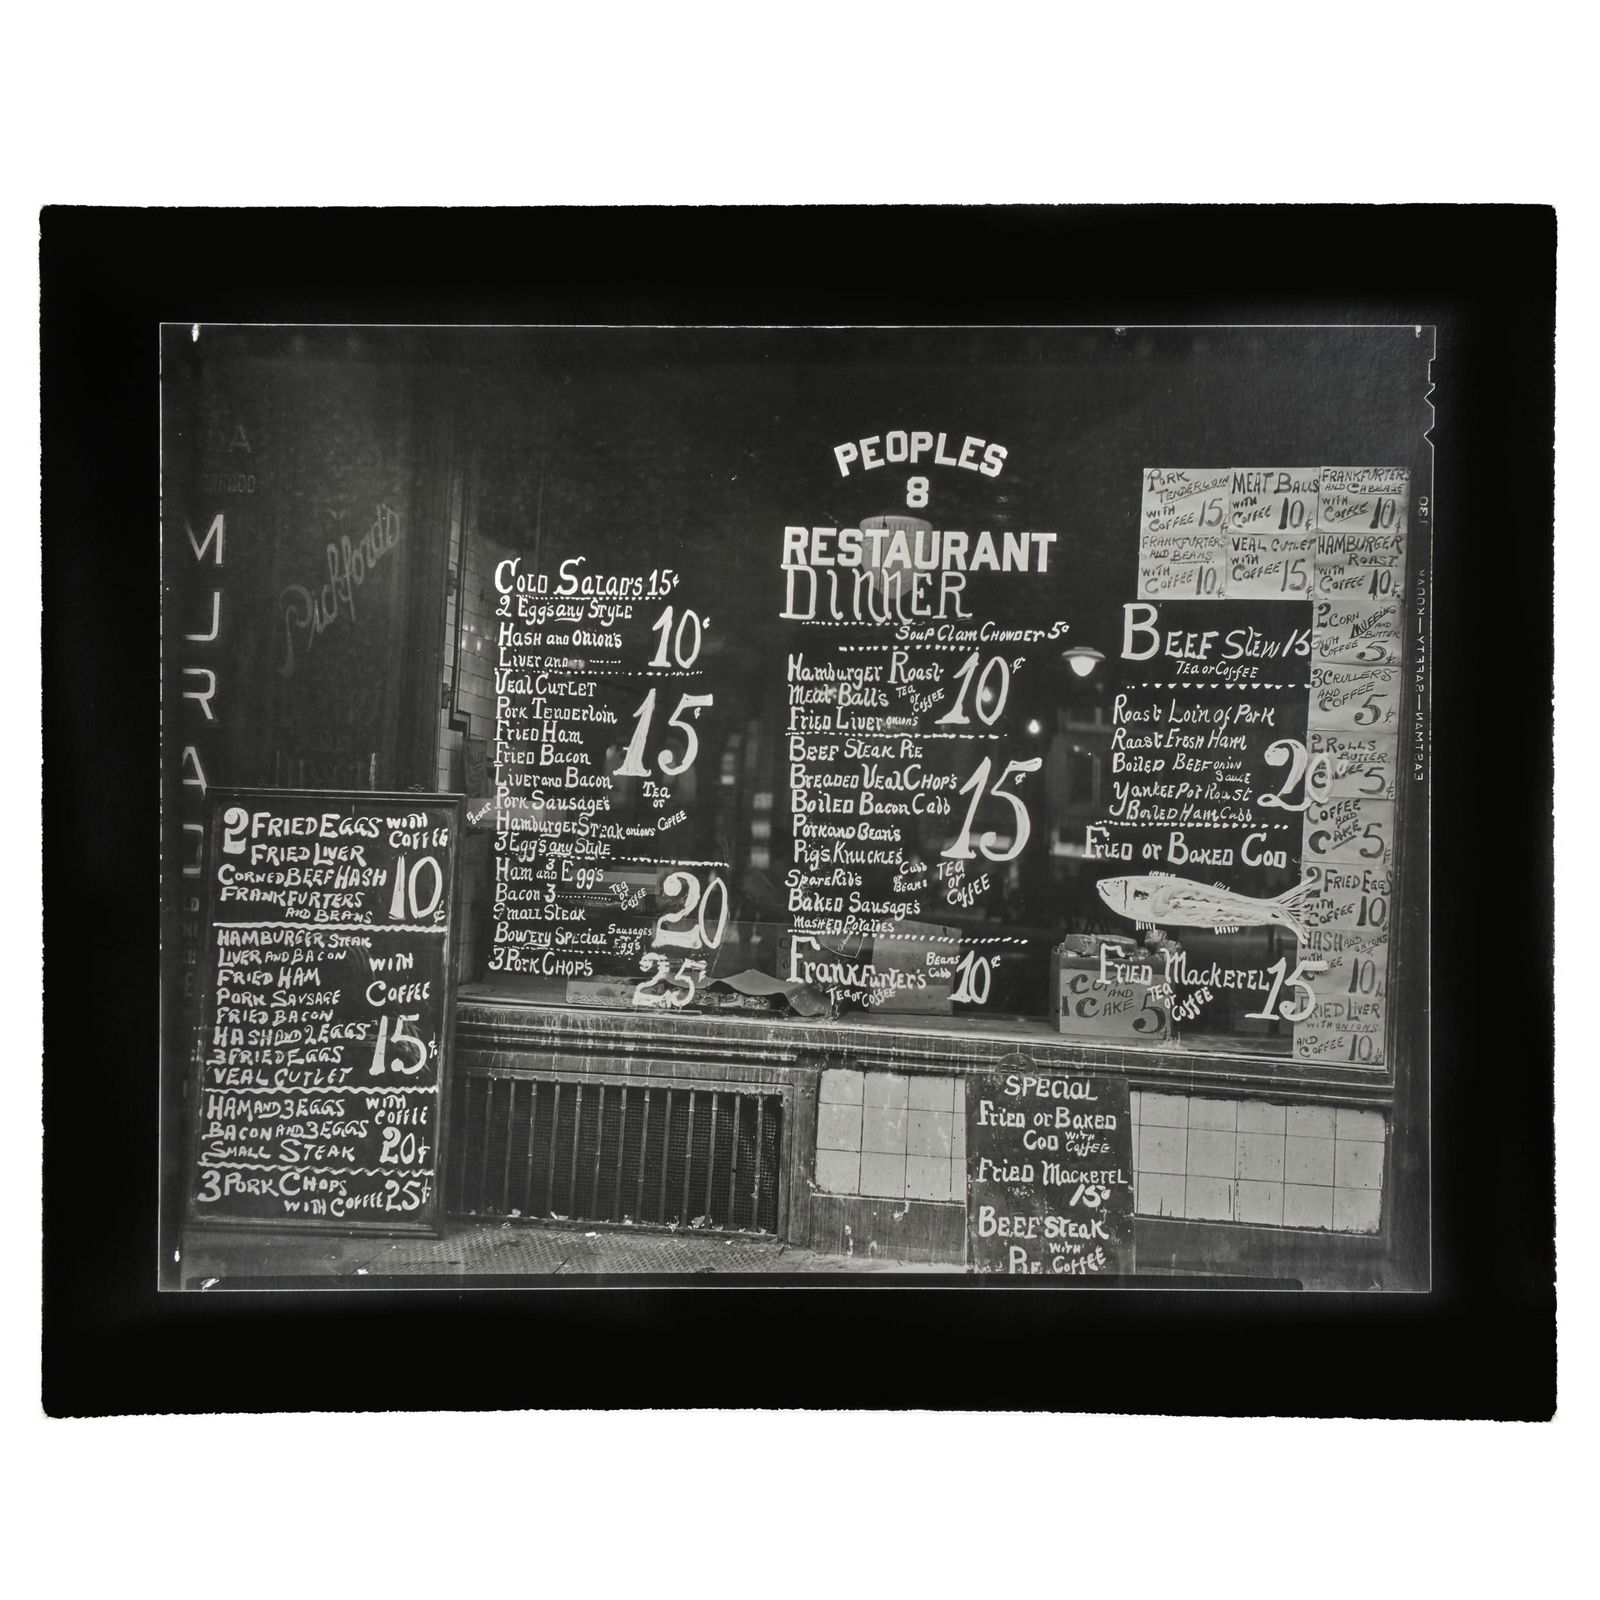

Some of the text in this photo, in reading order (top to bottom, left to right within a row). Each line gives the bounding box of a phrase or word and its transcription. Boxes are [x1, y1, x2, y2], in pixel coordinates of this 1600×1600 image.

[833, 431, 1008, 477] PEOPLES
[1148, 469, 1190, 492] PORK
[1232, 472, 1319, 494] MEAT BALLS
[1322, 468, 1410, 482] FRANKFURTERS
[906, 476, 929, 508] 8
[1156, 475, 1229, 503] TENDERLOIN
[1322, 496, 1348, 505] WITH
[1147, 505, 1175, 518] WITH
[1232, 505, 1272, 528] COFFEE
[1324, 502, 1369, 522] COFFEE
[1149, 513, 1194, 532] COFFEE
[782, 526, 1057, 573] RESTAURANT
[1142, 535, 1226, 549] FRANKFURTERS
[1232, 537, 1316, 552] VEAL CUTLET
[1317, 535, 1403, 554] HAMBURGER
[1231, 554, 1258, 565] WITH
[1318, 565, 1344, 575] WITH
[1142, 565, 1169, 576] WITH
[1232, 564, 1281, 581] COFFEE
[1145, 570, 1193, 594] COFFEE
[1320, 575, 1365, 593] COFFEE
[495, 595, 512, 617] 2
[1317, 603, 1359, 628] 2 CORN
[1312, 668, 1398, 688] 3 CRULLERS
[1317, 688, 1340, 699] AND
[1319, 681, 1375, 712] COFFEE
[1312, 734, 1376, 753] 2 ROLLS
[539, 744, 591, 765] Bacon
[564, 767, 613, 788] Bacon
[859, 791, 910, 816] Bacon
[223, 807, 383, 854] 2 FRIED EGGS
[1308, 821, 1361, 854] CAKE
[494, 832, 507, 851] 3
[252, 843, 366, 867] FRIED LIVER
[218, 864, 386, 889] CORNED BEEF HASH
[1324, 869, 1392, 896] FRIED EGGS
[220, 886, 365, 909] FRANKFURTERS
[497, 884, 541, 902] Bacon
[285, 907, 373, 924] AND BEANS
[217, 930, 372, 948] HAMBURGER STEAK
[218, 948, 347, 967] LIVER AND BACON
[217, 967, 320, 989] FRIED HAM
[217, 988, 341, 1008] PORK SAUSAGE
[1076, 997, 1135, 1018] CAKE
[217, 1009, 333, 1026] FRIED BACON
[213, 1026, 271, 1046] HASH
[274, 1032, 301, 1045] AND
[318, 1023, 371, 1040] EGGS
[206, 1045, 344, 1066] 3 FRIED EGGS
[215, 1067, 353, 1088] VEAL CUTLET
[207, 1094, 345, 1122] HAM AND EGGS
[202, 1120, 369, 1140] BACON EGGS
[201, 1139, 355, 1162] SMALL STEAK
[198, 1170, 347, 1201] 3 PORK CHOPS
